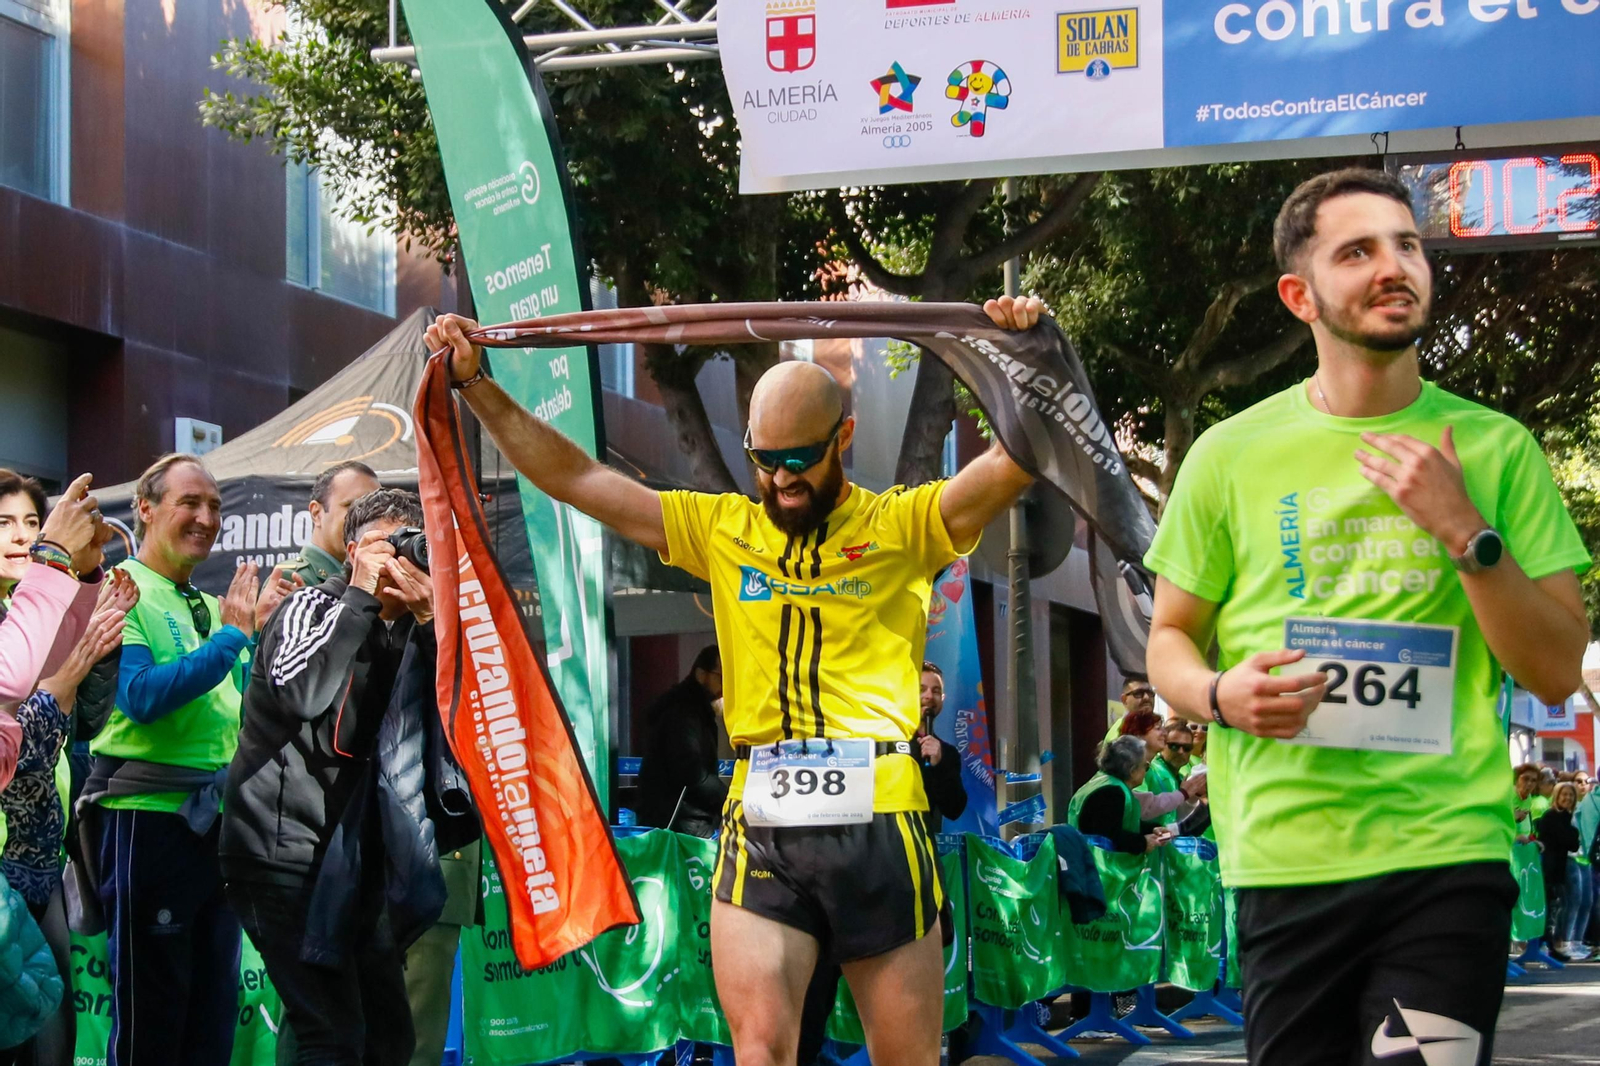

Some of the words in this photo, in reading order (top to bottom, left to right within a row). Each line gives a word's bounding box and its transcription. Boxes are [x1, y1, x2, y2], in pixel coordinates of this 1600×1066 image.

[884, 14, 951, 30] DEPORTES
[954, 13, 972, 24] DE
[1067, 42, 1081, 57] DE
[1085, 38, 1129, 55] CABRAS
[743, 79, 838, 110] ALMERÍA
[1195, 91, 1429, 122] #TodosContraElCáncer
[767, 108, 818, 124] CIUDAD
[860, 122, 902, 135] Almería
[906, 120, 933, 132] 2005
[870, 115, 890, 123] Juegos
[891, 112, 933, 121] Mediterráneos
[1306, 517, 1338, 538] En
[1273, 491, 1306, 599] ALMERÍA
[1309, 536, 1405, 564] contra
[1411, 536, 1440, 557] el
[1312, 565, 1442, 599] cáncer
[164, 611, 187, 656] LMERÍA
[1290, 636, 1328, 647] contra
[1330, 637, 1342, 648] el
[1316, 660, 1421, 709] 264
[770, 768, 846, 799] 398
